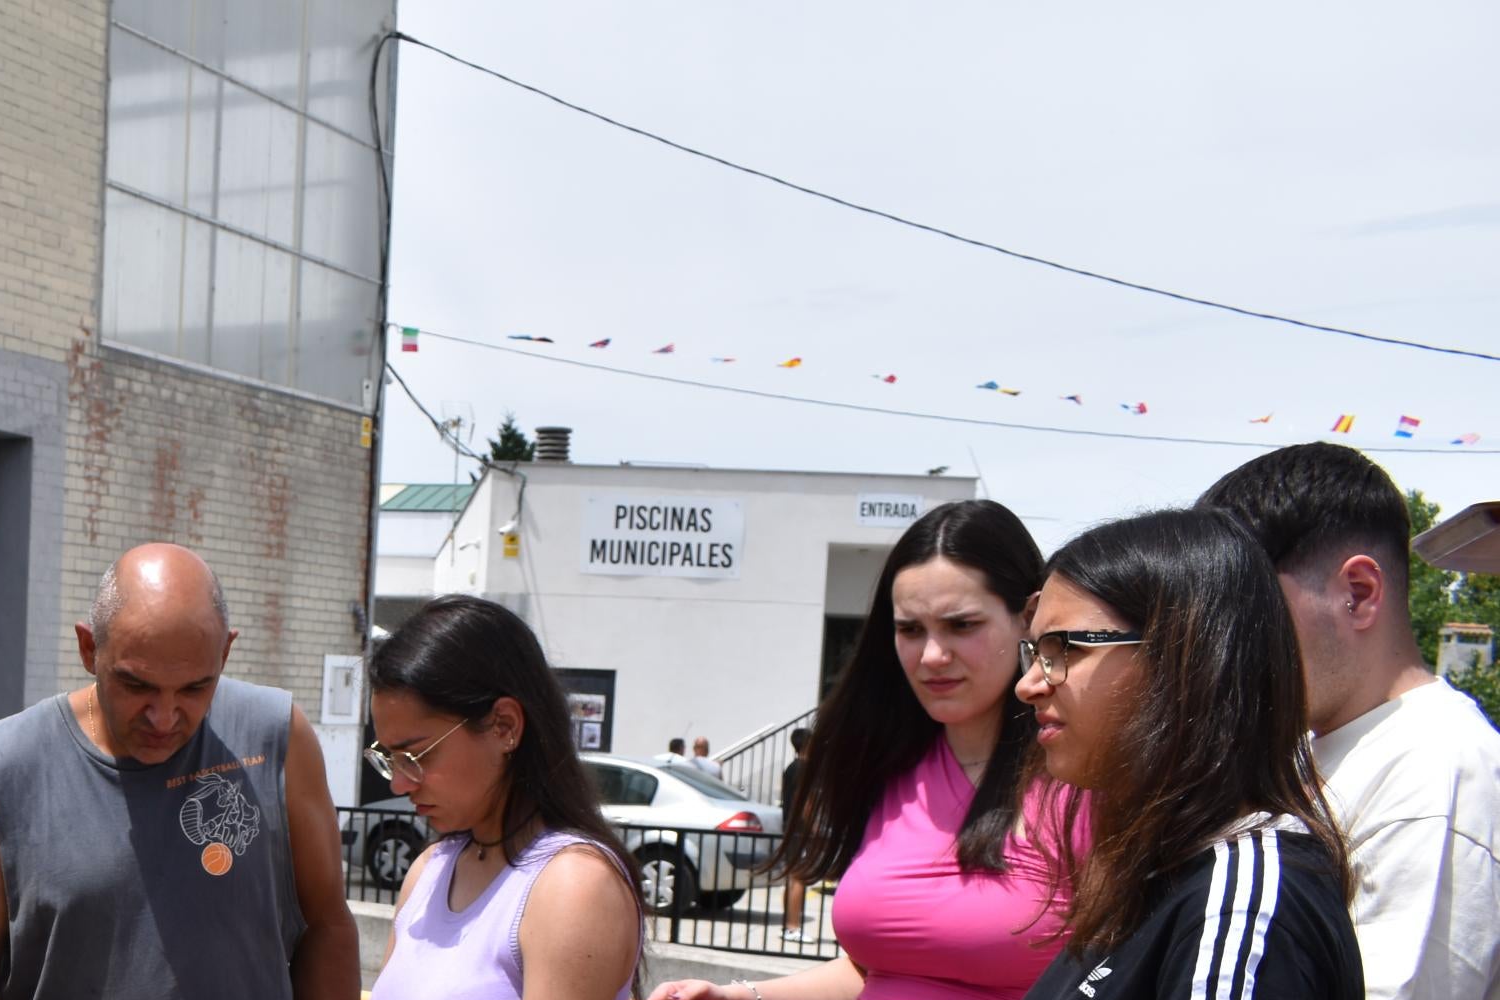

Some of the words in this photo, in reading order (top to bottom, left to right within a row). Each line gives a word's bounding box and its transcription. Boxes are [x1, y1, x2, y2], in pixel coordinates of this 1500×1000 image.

[614, 504, 713, 533] PISCINAS
[859, 501, 918, 520] ENTRADA
[589, 539, 734, 569] MUNICIPALES
